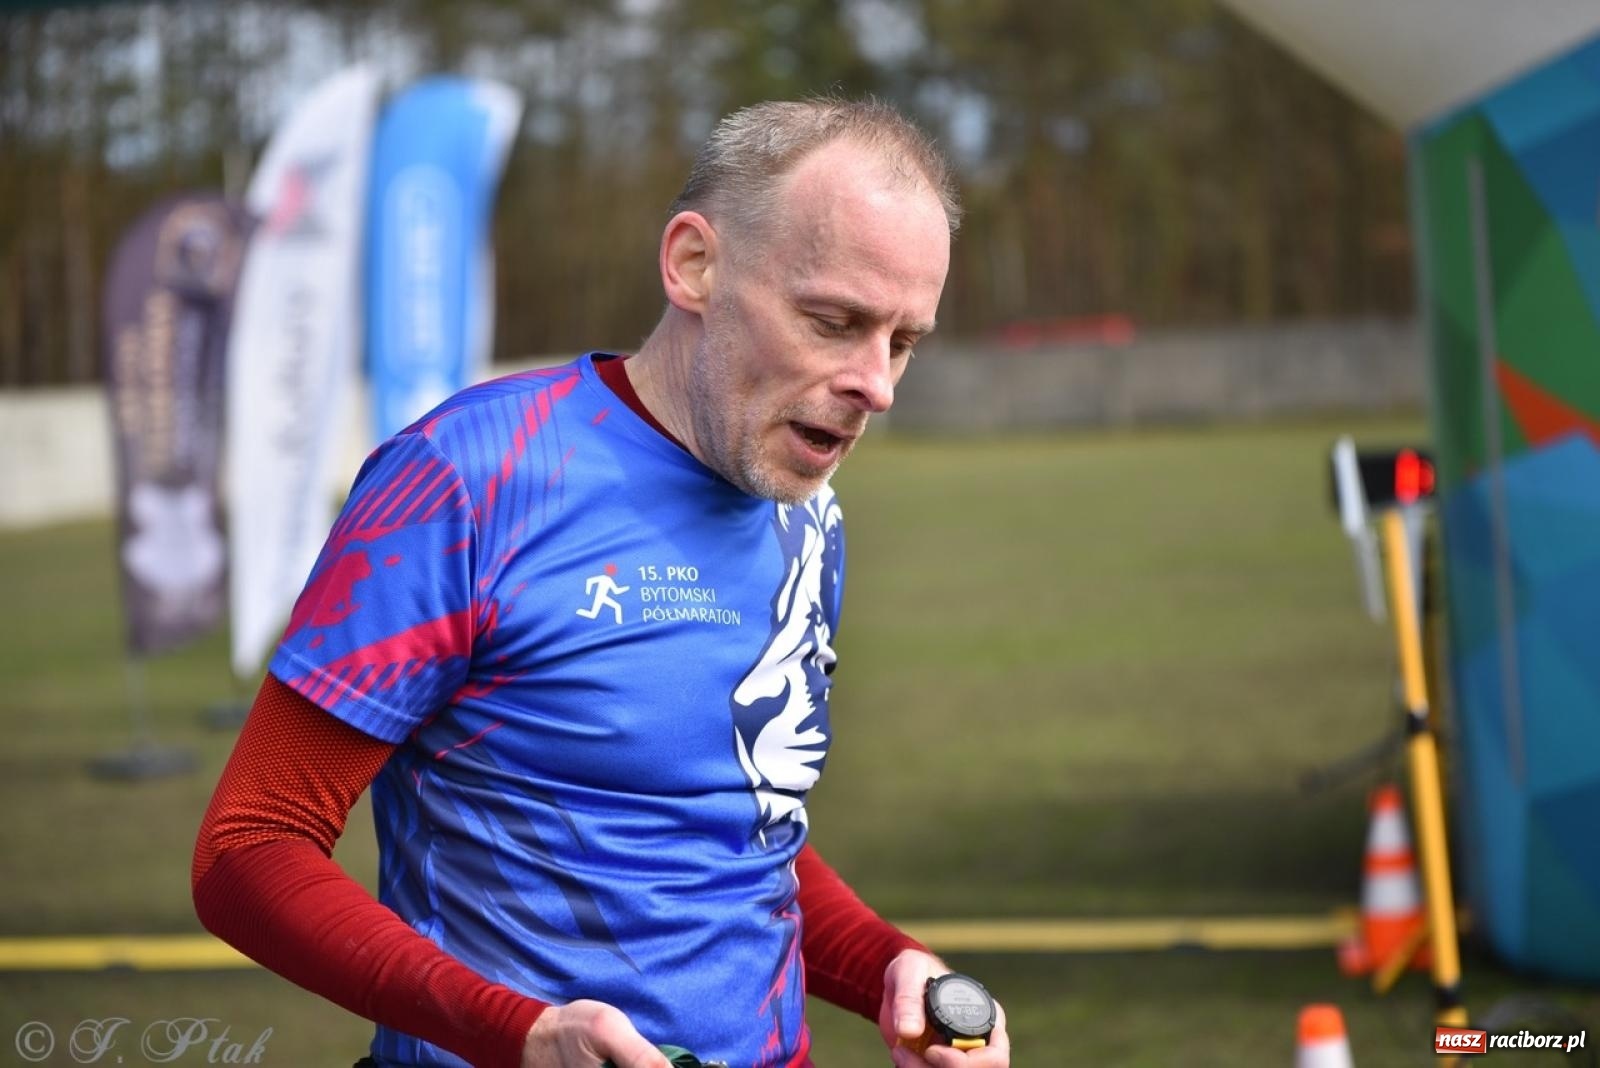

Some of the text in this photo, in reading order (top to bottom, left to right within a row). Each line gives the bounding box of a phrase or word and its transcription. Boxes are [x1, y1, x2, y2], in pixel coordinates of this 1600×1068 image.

[638, 565, 699, 582] 15. PKO
[640, 587, 716, 603] BYTOMSKI
[642, 605, 741, 626] PÓŁMARATON
